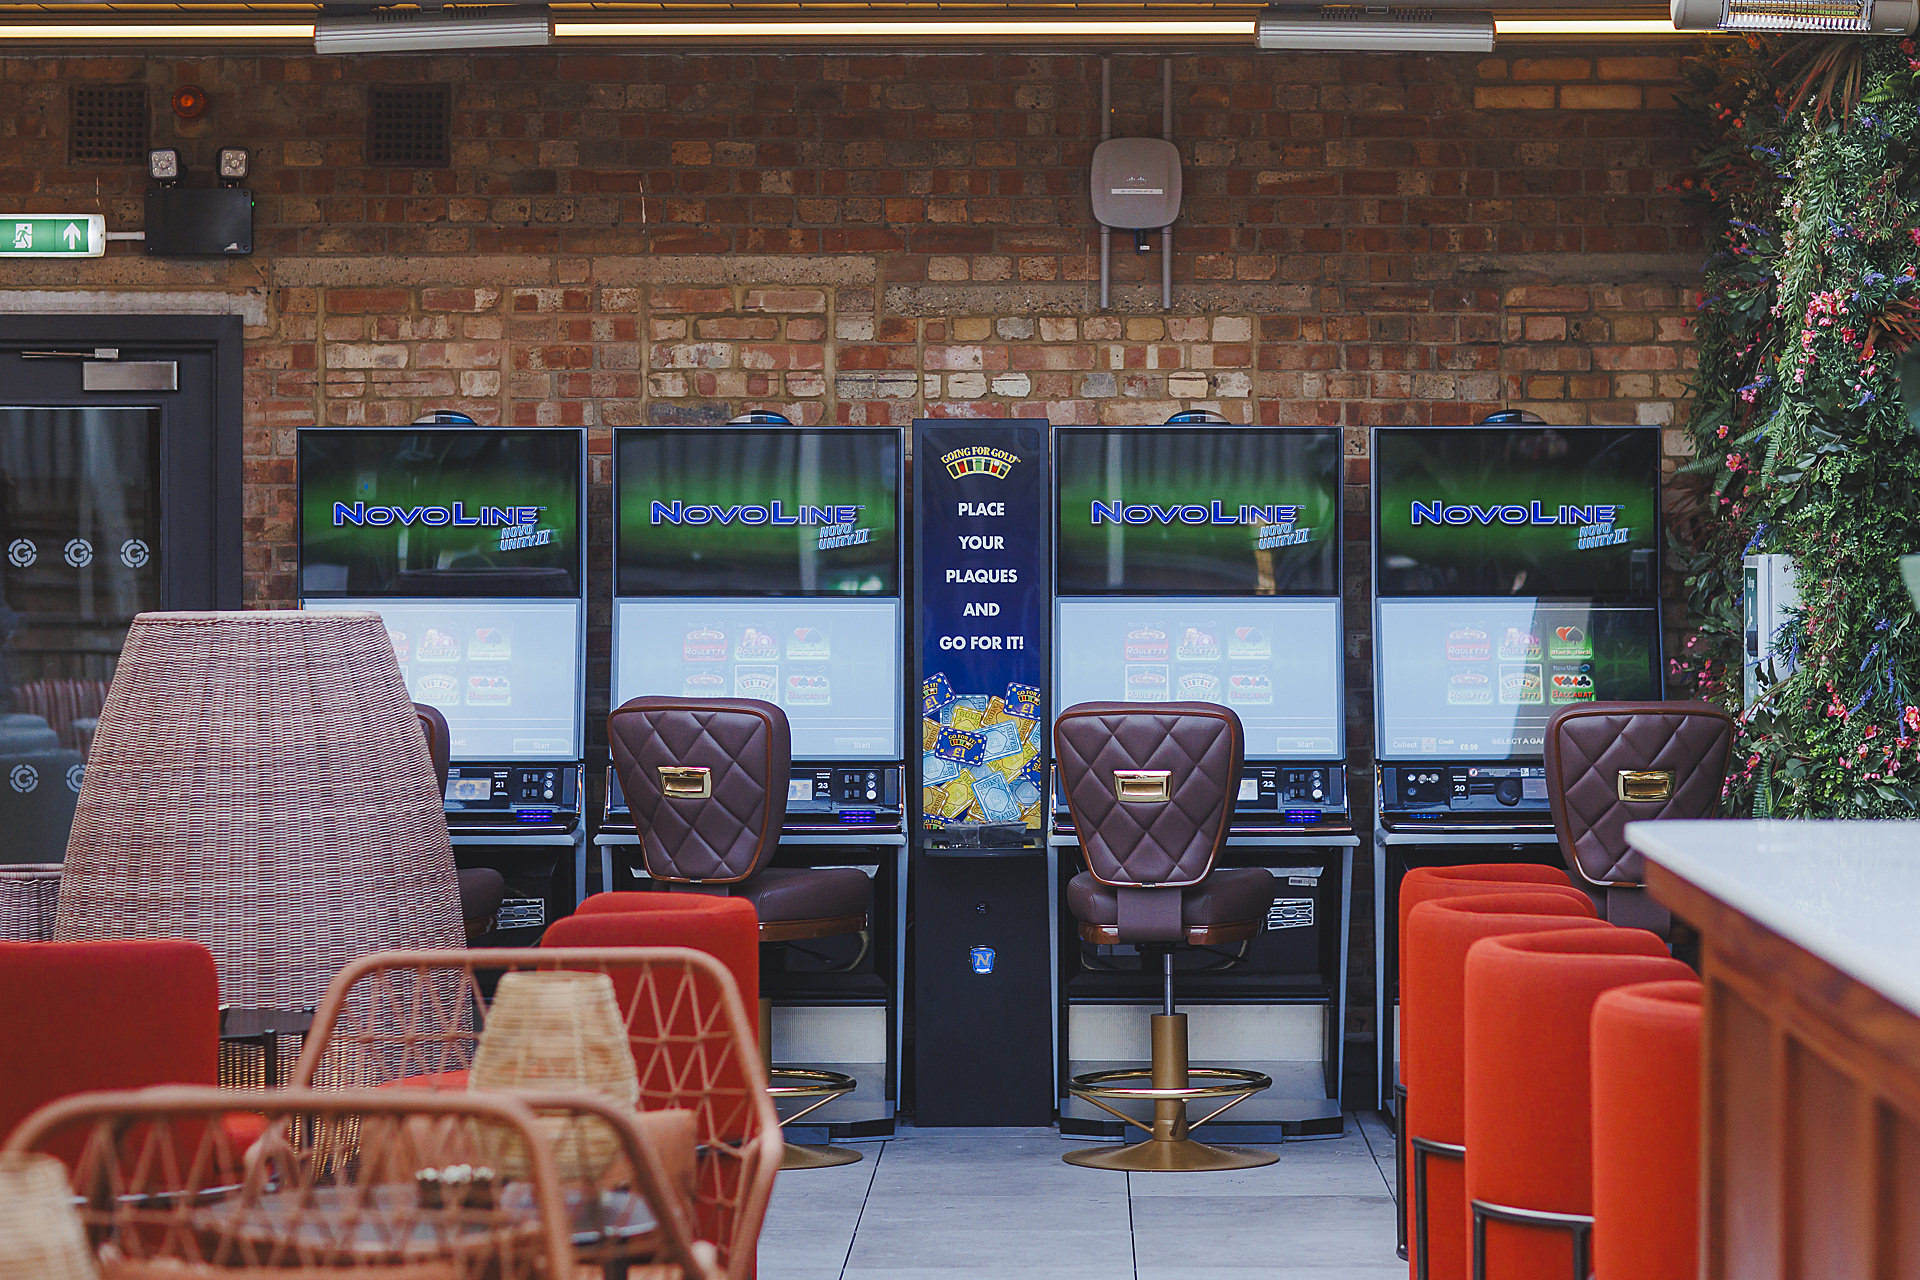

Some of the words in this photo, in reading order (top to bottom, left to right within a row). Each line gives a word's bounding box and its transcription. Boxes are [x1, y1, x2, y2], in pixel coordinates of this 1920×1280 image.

[940, 447, 970, 464] GOING
[972, 446, 991, 456] FOR
[991, 448, 1016, 464] GOLD
[958, 502, 1004, 516] PLACE
[501, 525, 533, 539] NOVO
[819, 524, 852, 538] NOVO
[1260, 523, 1292, 538] NOVO
[1578, 523, 1612, 538] NOVO
[500, 537, 536, 551] UNITY
[535, 529, 550, 546] II
[818, 536, 854, 550] UNITY
[854, 528, 870, 544] II
[958, 536, 1004, 550] YOUR
[1258, 536, 1294, 550] UNITY
[1294, 528, 1310, 544] II
[1578, 536, 1614, 550] UNITY
[1614, 527, 1629, 544] II
[946, 569, 1018, 584] PLAQUES
[963, 603, 1000, 616] AND
[939, 636, 966, 650] GO
[970, 636, 1002, 650] FOR
[1006, 636, 1024, 650] IT!
[1552, 690, 1593, 698] BACCARAT
[1021, 704, 1034, 714] £1
[853, 740, 871, 749] Start
[1297, 740, 1314, 748] Start
[1392, 740, 1417, 748] Collect
[952, 748, 966, 758] £1
[1263, 780, 1275, 788] 22
[975, 954, 991, 966] N
